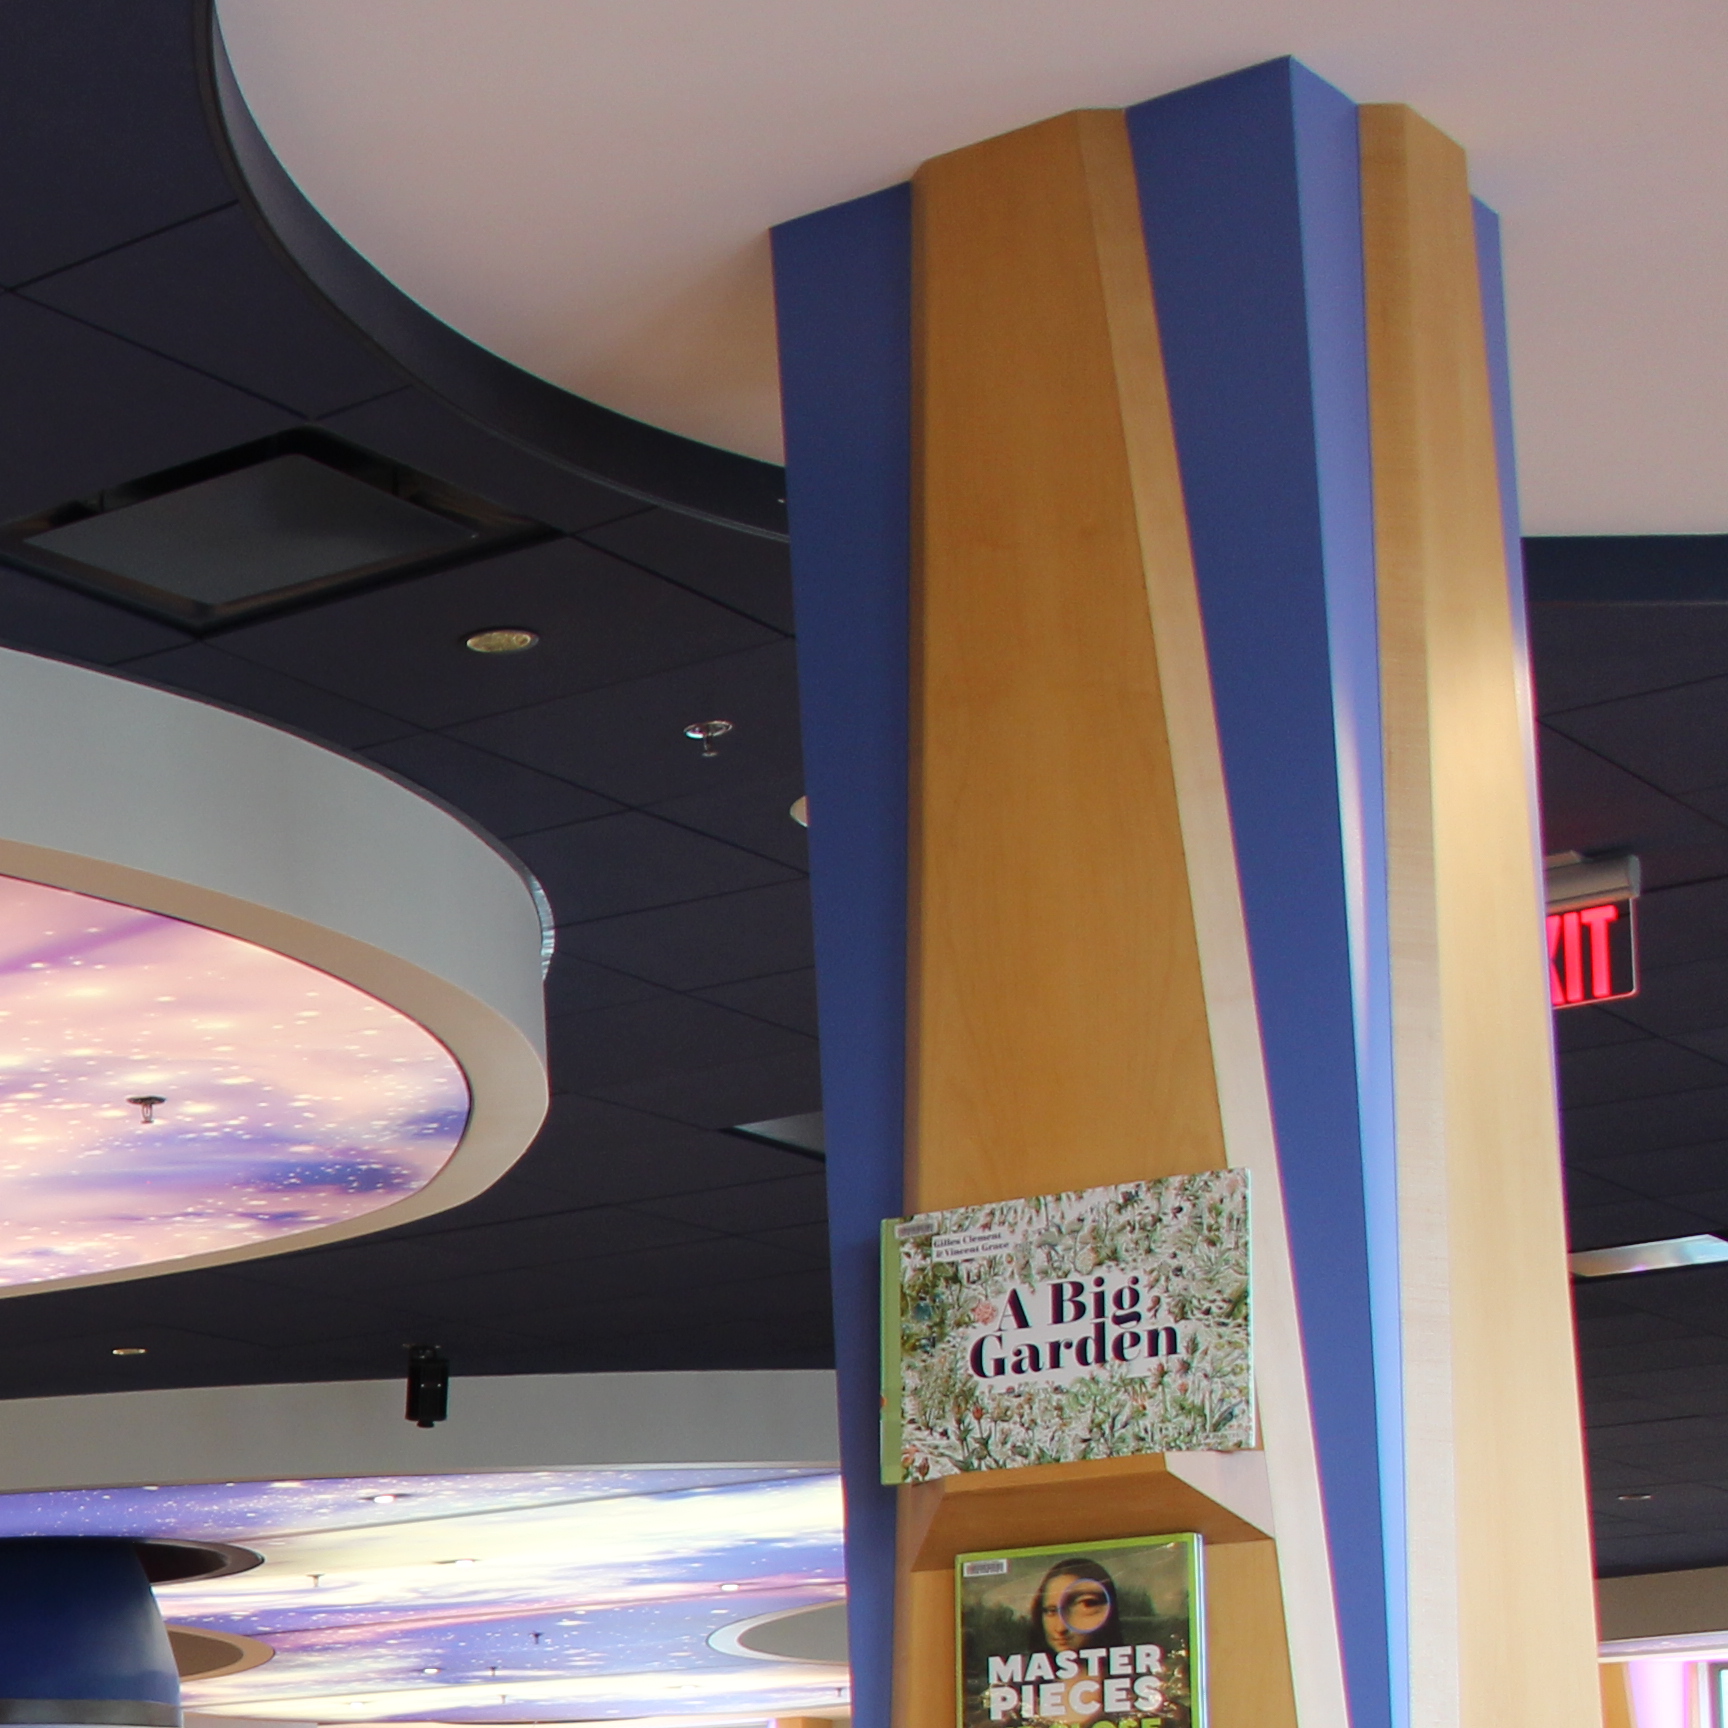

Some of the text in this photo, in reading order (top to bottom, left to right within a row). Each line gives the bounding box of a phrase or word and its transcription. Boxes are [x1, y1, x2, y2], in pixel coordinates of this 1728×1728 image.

[1546, 905, 1619, 1005] XIT
[995, 1276, 1143, 1332] A Big
[969, 1321, 1181, 1379] Garden
[988, 1644, 1164, 1684] MASTER
[989, 1675, 1164, 1721] PIECES
